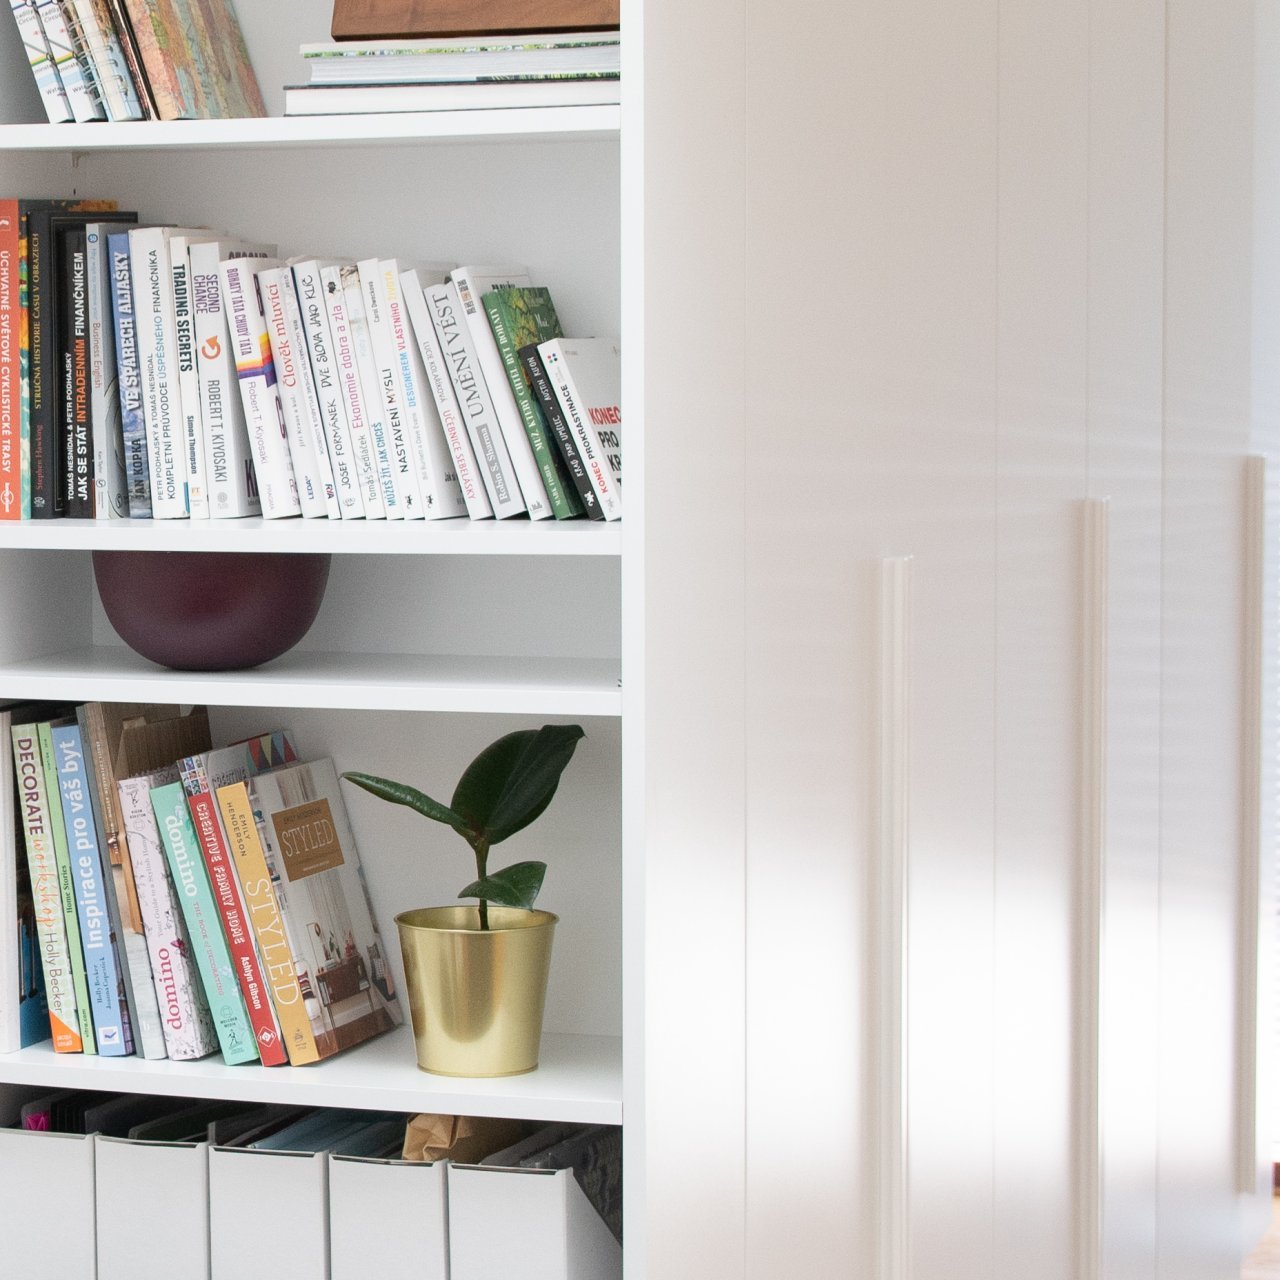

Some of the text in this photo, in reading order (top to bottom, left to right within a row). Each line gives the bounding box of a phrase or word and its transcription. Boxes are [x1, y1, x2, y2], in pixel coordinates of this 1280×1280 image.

[0, 250, 11, 311] ÚCHVATNÉ
[32, 233, 40, 283] OBRAZECH
[32, 294, 41, 319] ČASU
[173, 264, 193, 372] TRADING SECRETS
[193, 275, 208, 315] CHANCE
[205, 274, 220, 313] SECOND
[308, 304, 321, 327] JAKO
[332, 304, 344, 323] zla
[0, 314, 11, 363] SVĚTOVÉ
[33, 321, 41, 363] HISTORIE
[113, 251, 141, 412] VE SPÁRECH ALJAŠKY
[268, 283, 297, 388] Člověk mluvící
[390, 302, 407, 351] VLASTNÍHO
[433, 294, 461, 345] VÉST
[92, 322, 102, 389] Business English
[313, 331, 328, 362] SLOVA
[340, 336, 353, 369] dobra
[32, 365, 42, 409] STRUČNÁ
[64, 352, 73, 401] PODHAJSKÝ
[72, 252, 88, 501] JAK SE STÁT INTRADENNÍM FINANČNÍKEM
[149, 249, 175, 499] KOMPLETNÍ PRŮVODCE ÚSPĚŠNÉHO FINANČNÍKA
[446, 348, 485, 418] UMĚNÍ
[537, 378, 552, 401] AUSTIN
[1, 366, 11, 436] CYKLISTICKÉ
[149, 393, 158, 422] TOMÁŠ
[247, 381, 268, 465] Robert Kiyosaki
[345, 372, 364, 429] Ekonomie
[382, 368, 409, 473] NASTAVENÍ MYSLI
[560, 384, 595, 460] PROKRASTINACE
[588, 406, 621, 425] KONEC
[186, 415, 197, 475] Simon Thompson
[207, 379, 228, 483] ROBERT T. KIYOSAKI
[327, 398, 344, 456] FORMÁNEK
[372, 422, 386, 448] CHCEŠ
[481, 427, 496, 461] Sharma
[598, 430, 620, 449] PRO
[1, 439, 11, 473] TRASY
[35, 424, 45, 490] Stephen Hawking
[65, 432, 74, 472] NESNÍDAL
[131, 438, 145, 500] JAN KOPKA
[150, 430, 163, 478] PODHAJSKÝ
[338, 461, 351, 489] JOSEF
[357, 434, 372, 473] Sedláček
[378, 449, 389, 463] JAK
[442, 409, 461, 451] UČEBNICE
[455, 452, 477, 500] SEBELÁSKY
[65, 474, 74, 500] TOMÁŠ
[155, 480, 164, 501] PETR
[306, 479, 315, 500] LEDA
[324, 483, 335, 499] RYA
[365, 475, 377, 502] Tomáš
[495, 473, 508, 501] Robin
[590, 461, 609, 494] KONEC
[17, 738, 61, 929] DECORATE workshop
[59, 739, 104, 949] Inspirace pro váš byt
[226, 802, 247, 857] HENDERSON
[238, 814, 251, 840] EMILY
[281, 818, 335, 858] STYLED
[165, 814, 198, 897] domino
[196, 801, 245, 945] CREATIVE FAMILY HOME
[60, 864, 73, 914] Home Stories
[245, 878, 299, 1005] STYLED
[44, 928, 64, 1014] Holly Becker
[91, 964, 104, 1003] Holly Becker
[158, 948, 183, 1030] domino
[240, 956, 262, 1010] Ashlyn Gibson
